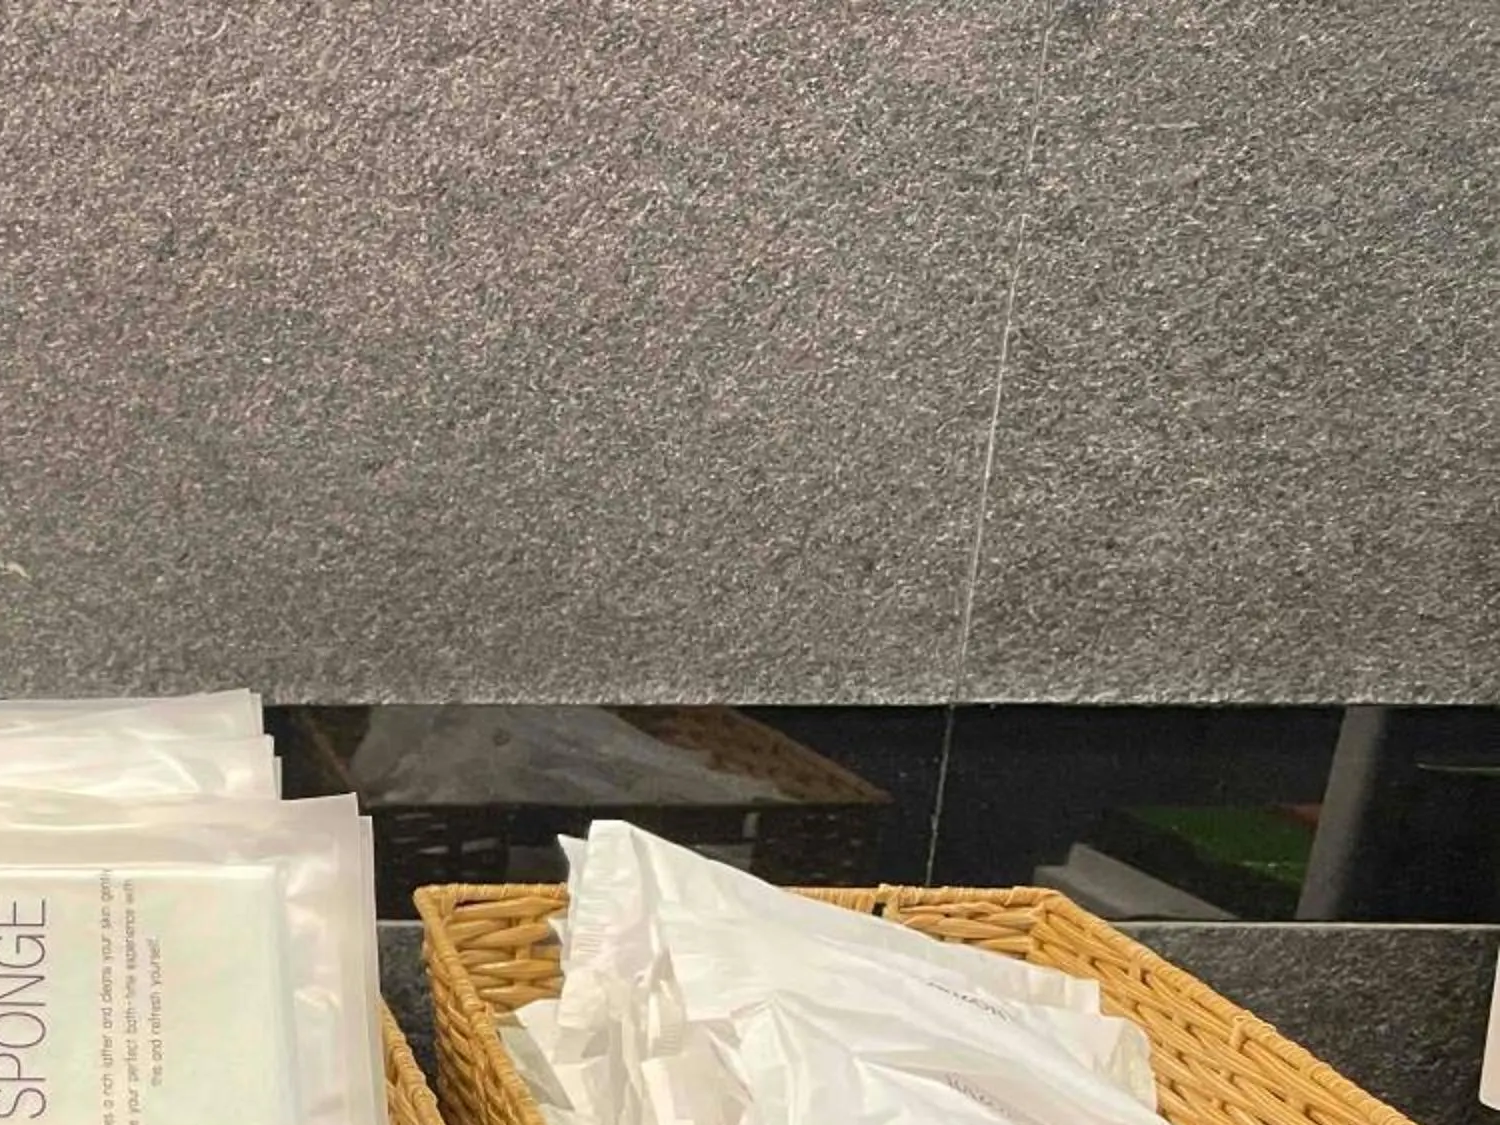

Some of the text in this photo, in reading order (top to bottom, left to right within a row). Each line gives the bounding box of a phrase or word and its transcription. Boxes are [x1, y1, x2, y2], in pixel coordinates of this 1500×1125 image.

[101, 932, 114, 962] your
[125, 909, 138, 970] experience
[100, 1007, 113, 1028] and
[147, 991, 162, 1035] refresh
[122, 1039, 140, 1082] perfect
[148, 1039, 162, 1061] and
[127, 1087, 140, 1112] your
